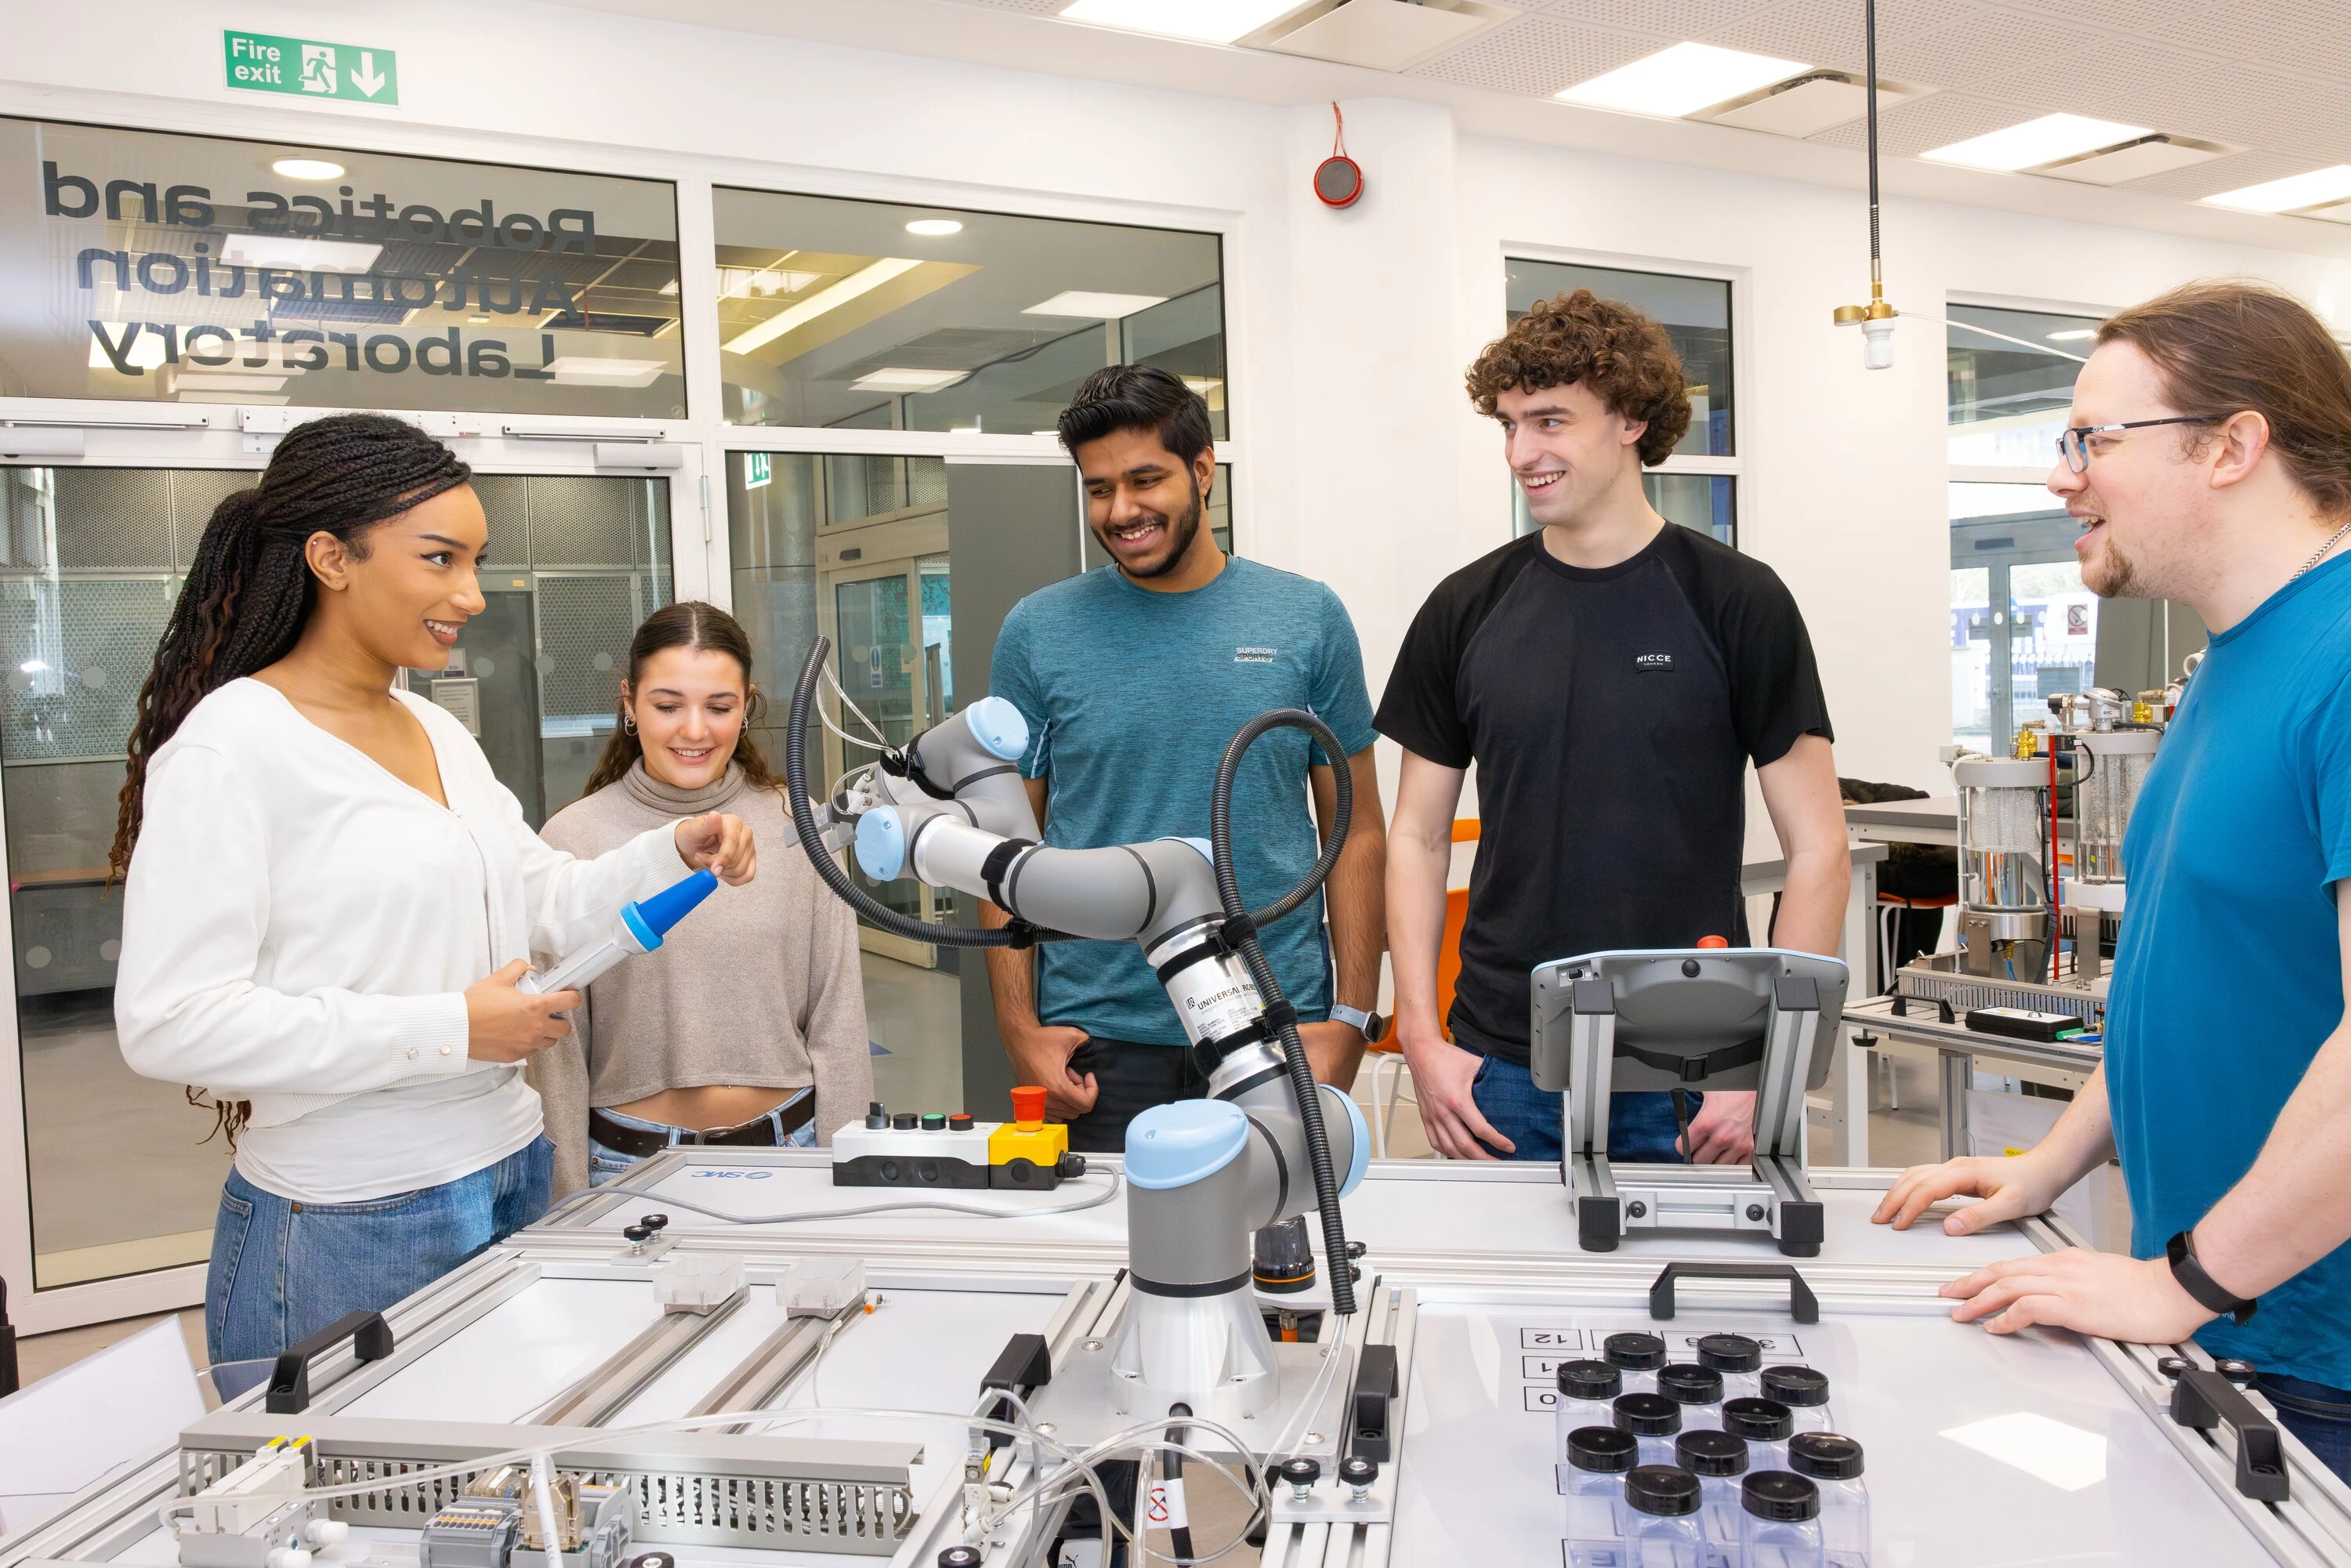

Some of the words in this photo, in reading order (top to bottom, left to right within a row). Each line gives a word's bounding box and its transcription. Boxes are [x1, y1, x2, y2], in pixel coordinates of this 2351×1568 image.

[232, 38, 281, 62] Fire
[235, 63, 282, 85] exit
[1636, 654, 1672, 663] NICCE
[1197, 986, 1241, 1010] UNIVERSAL
[1534, 1334, 1568, 1344] 12
[1541, 1363, 1563, 1372] 1
